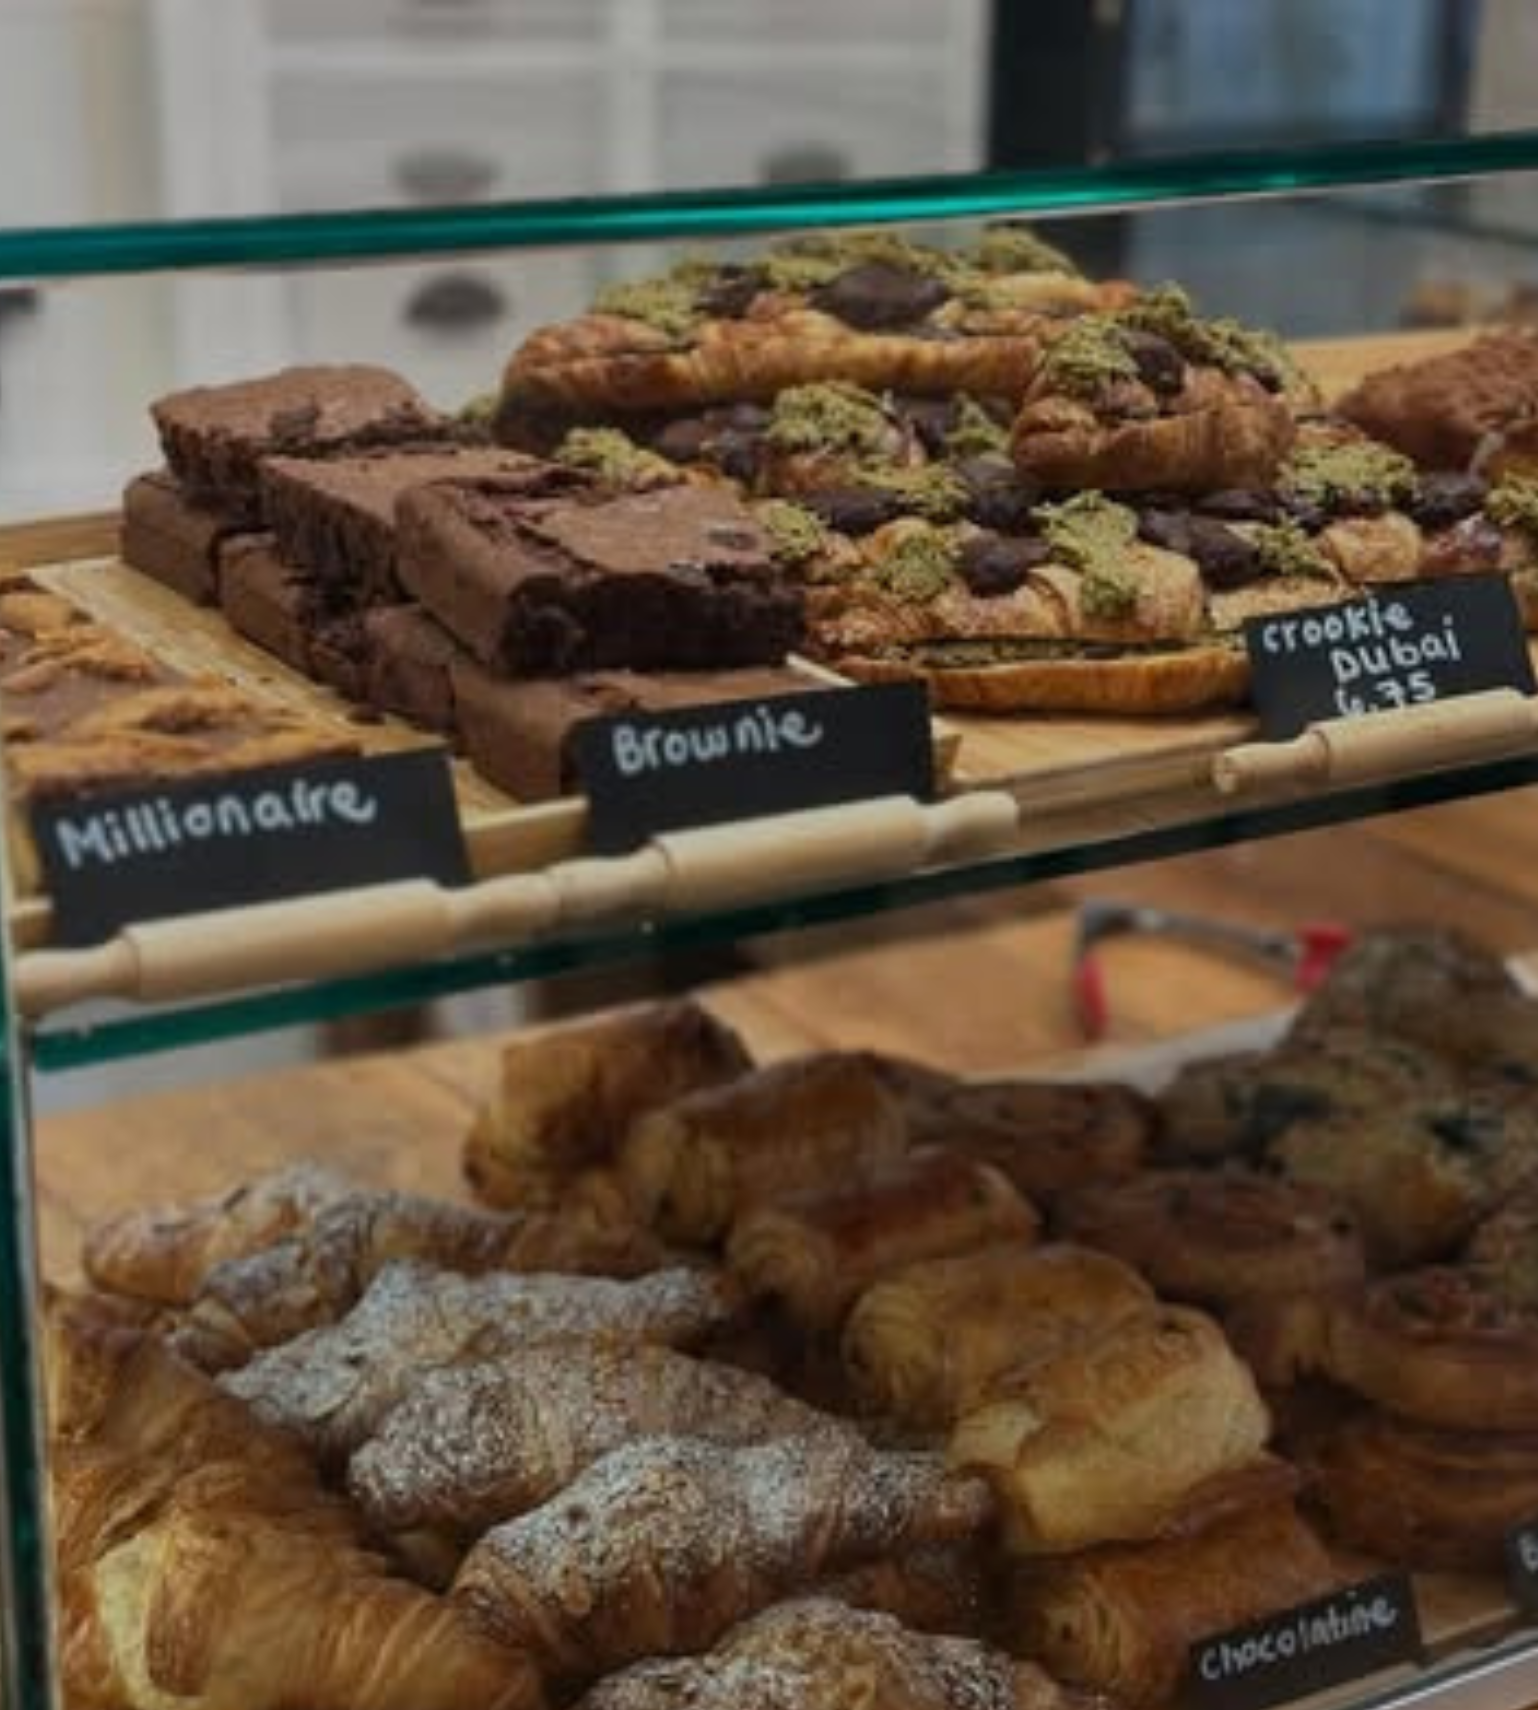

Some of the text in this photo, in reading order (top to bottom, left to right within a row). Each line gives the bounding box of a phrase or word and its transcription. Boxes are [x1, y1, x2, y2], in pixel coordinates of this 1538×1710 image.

[1330, 615, 1461, 683] Dubai
[611, 705, 823, 776] Brownie
[56, 780, 377, 869] Millionaire
